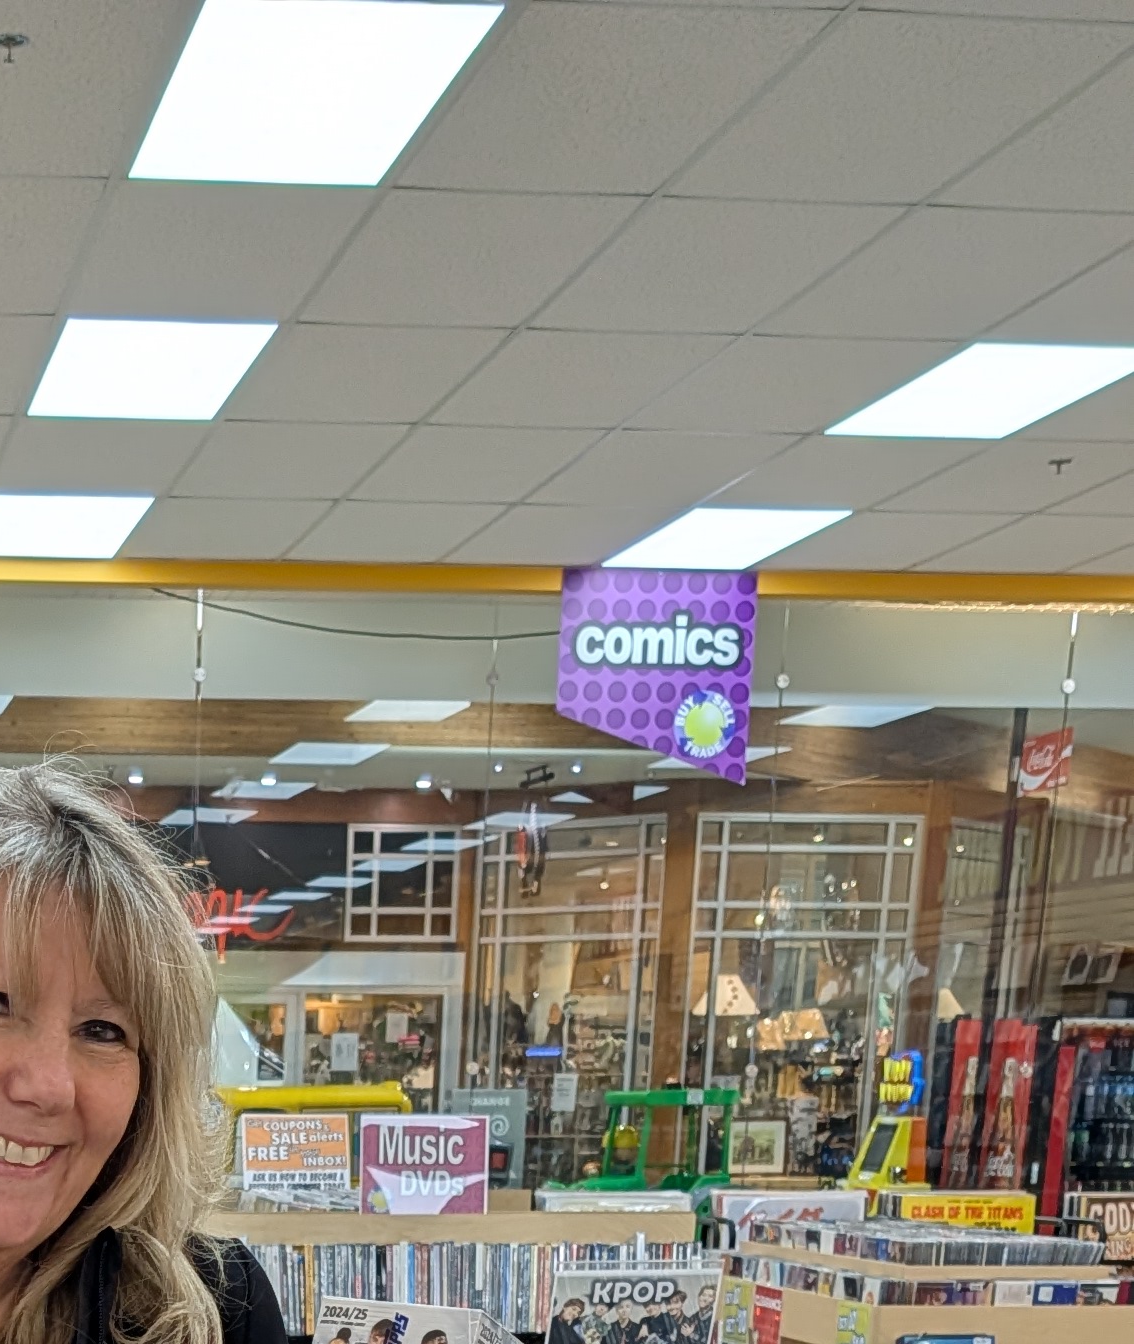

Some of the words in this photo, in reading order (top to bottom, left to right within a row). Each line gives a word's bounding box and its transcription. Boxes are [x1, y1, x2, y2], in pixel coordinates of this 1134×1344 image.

[575, 615, 740, 666] comics
[674, 695, 695, 727] BUY
[712, 692, 736, 729] SELL
[683, 740, 724, 759] TRADE
[263, 1120, 323, 1131] COUPONS
[271, 1132, 308, 1145] SALE
[309, 1132, 344, 1142] alerts
[378, 1125, 464, 1165] Music
[247, 1146, 289, 1161] FREE
[303, 1156, 347, 1167] INBOX!
[400, 1171, 464, 1196] DVDs
[911, 1205, 945, 1219] CLASH
[948, 1205, 961, 1219] OF
[964, 1206, 984, 1219] THE
[986, 1206, 1024, 1220] TITANS
[592, 1281, 676, 1304] KPOP
[322, 1305, 368, 1320] 2024/25
